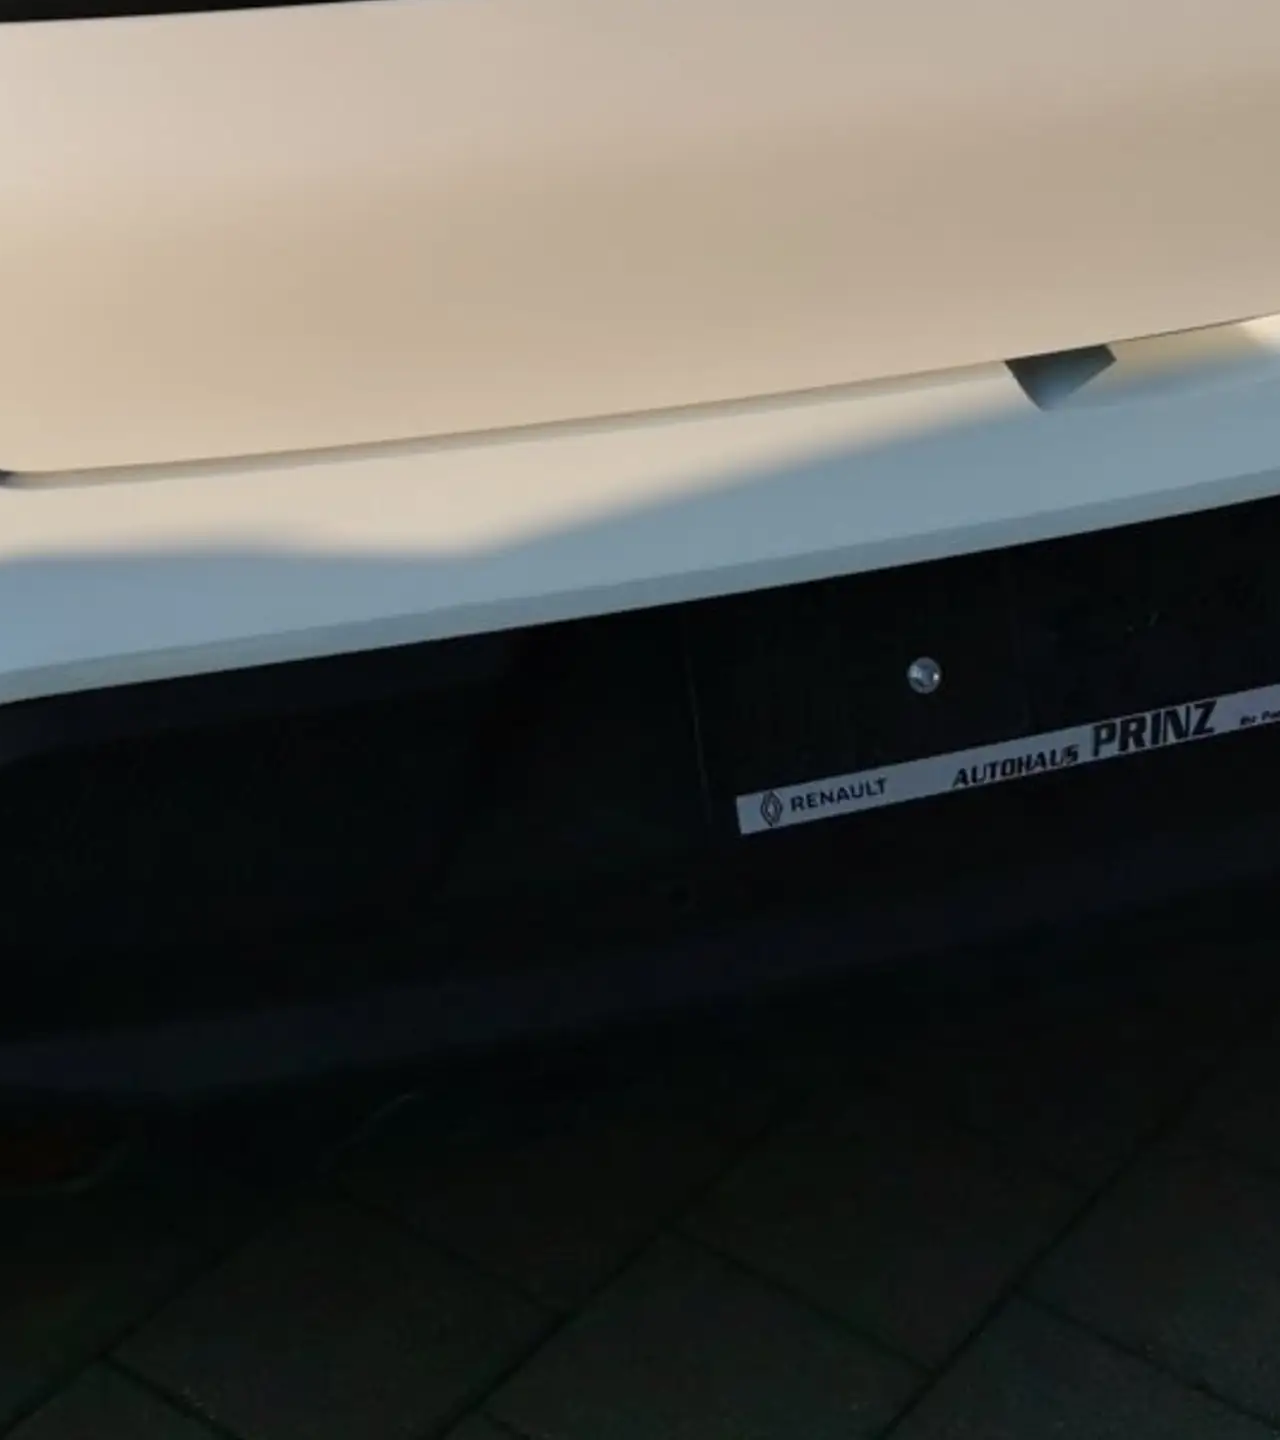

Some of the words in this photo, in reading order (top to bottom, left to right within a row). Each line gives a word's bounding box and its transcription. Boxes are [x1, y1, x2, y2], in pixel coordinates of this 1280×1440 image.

[789, 776, 888, 813] RENAULT
[951, 743, 1080, 789] AUTOHAUS
[1090, 700, 1218, 757] PRINZ
